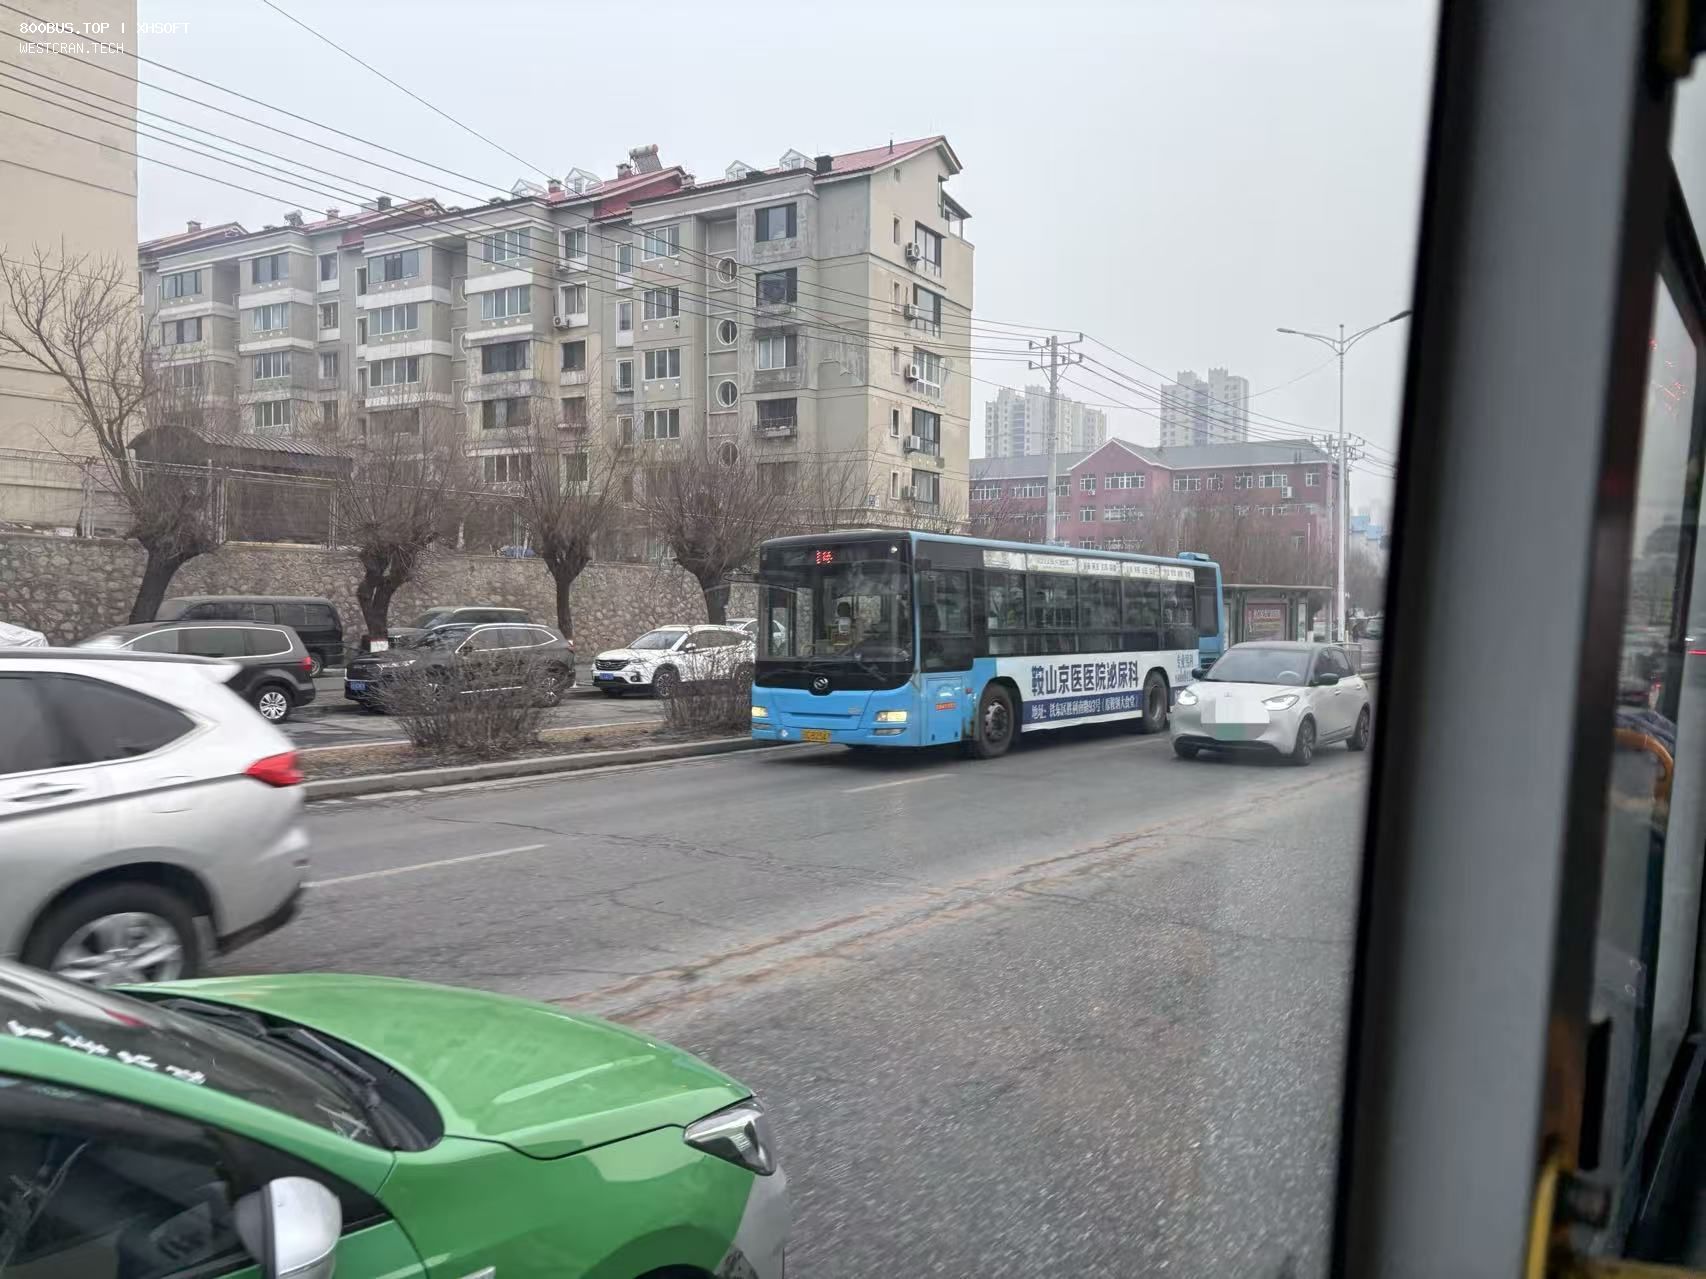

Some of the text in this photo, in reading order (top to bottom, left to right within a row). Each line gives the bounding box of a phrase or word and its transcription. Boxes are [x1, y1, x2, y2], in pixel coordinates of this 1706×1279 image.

[1031, 660, 1139, 697] 鞍山京医医院泌尿科
